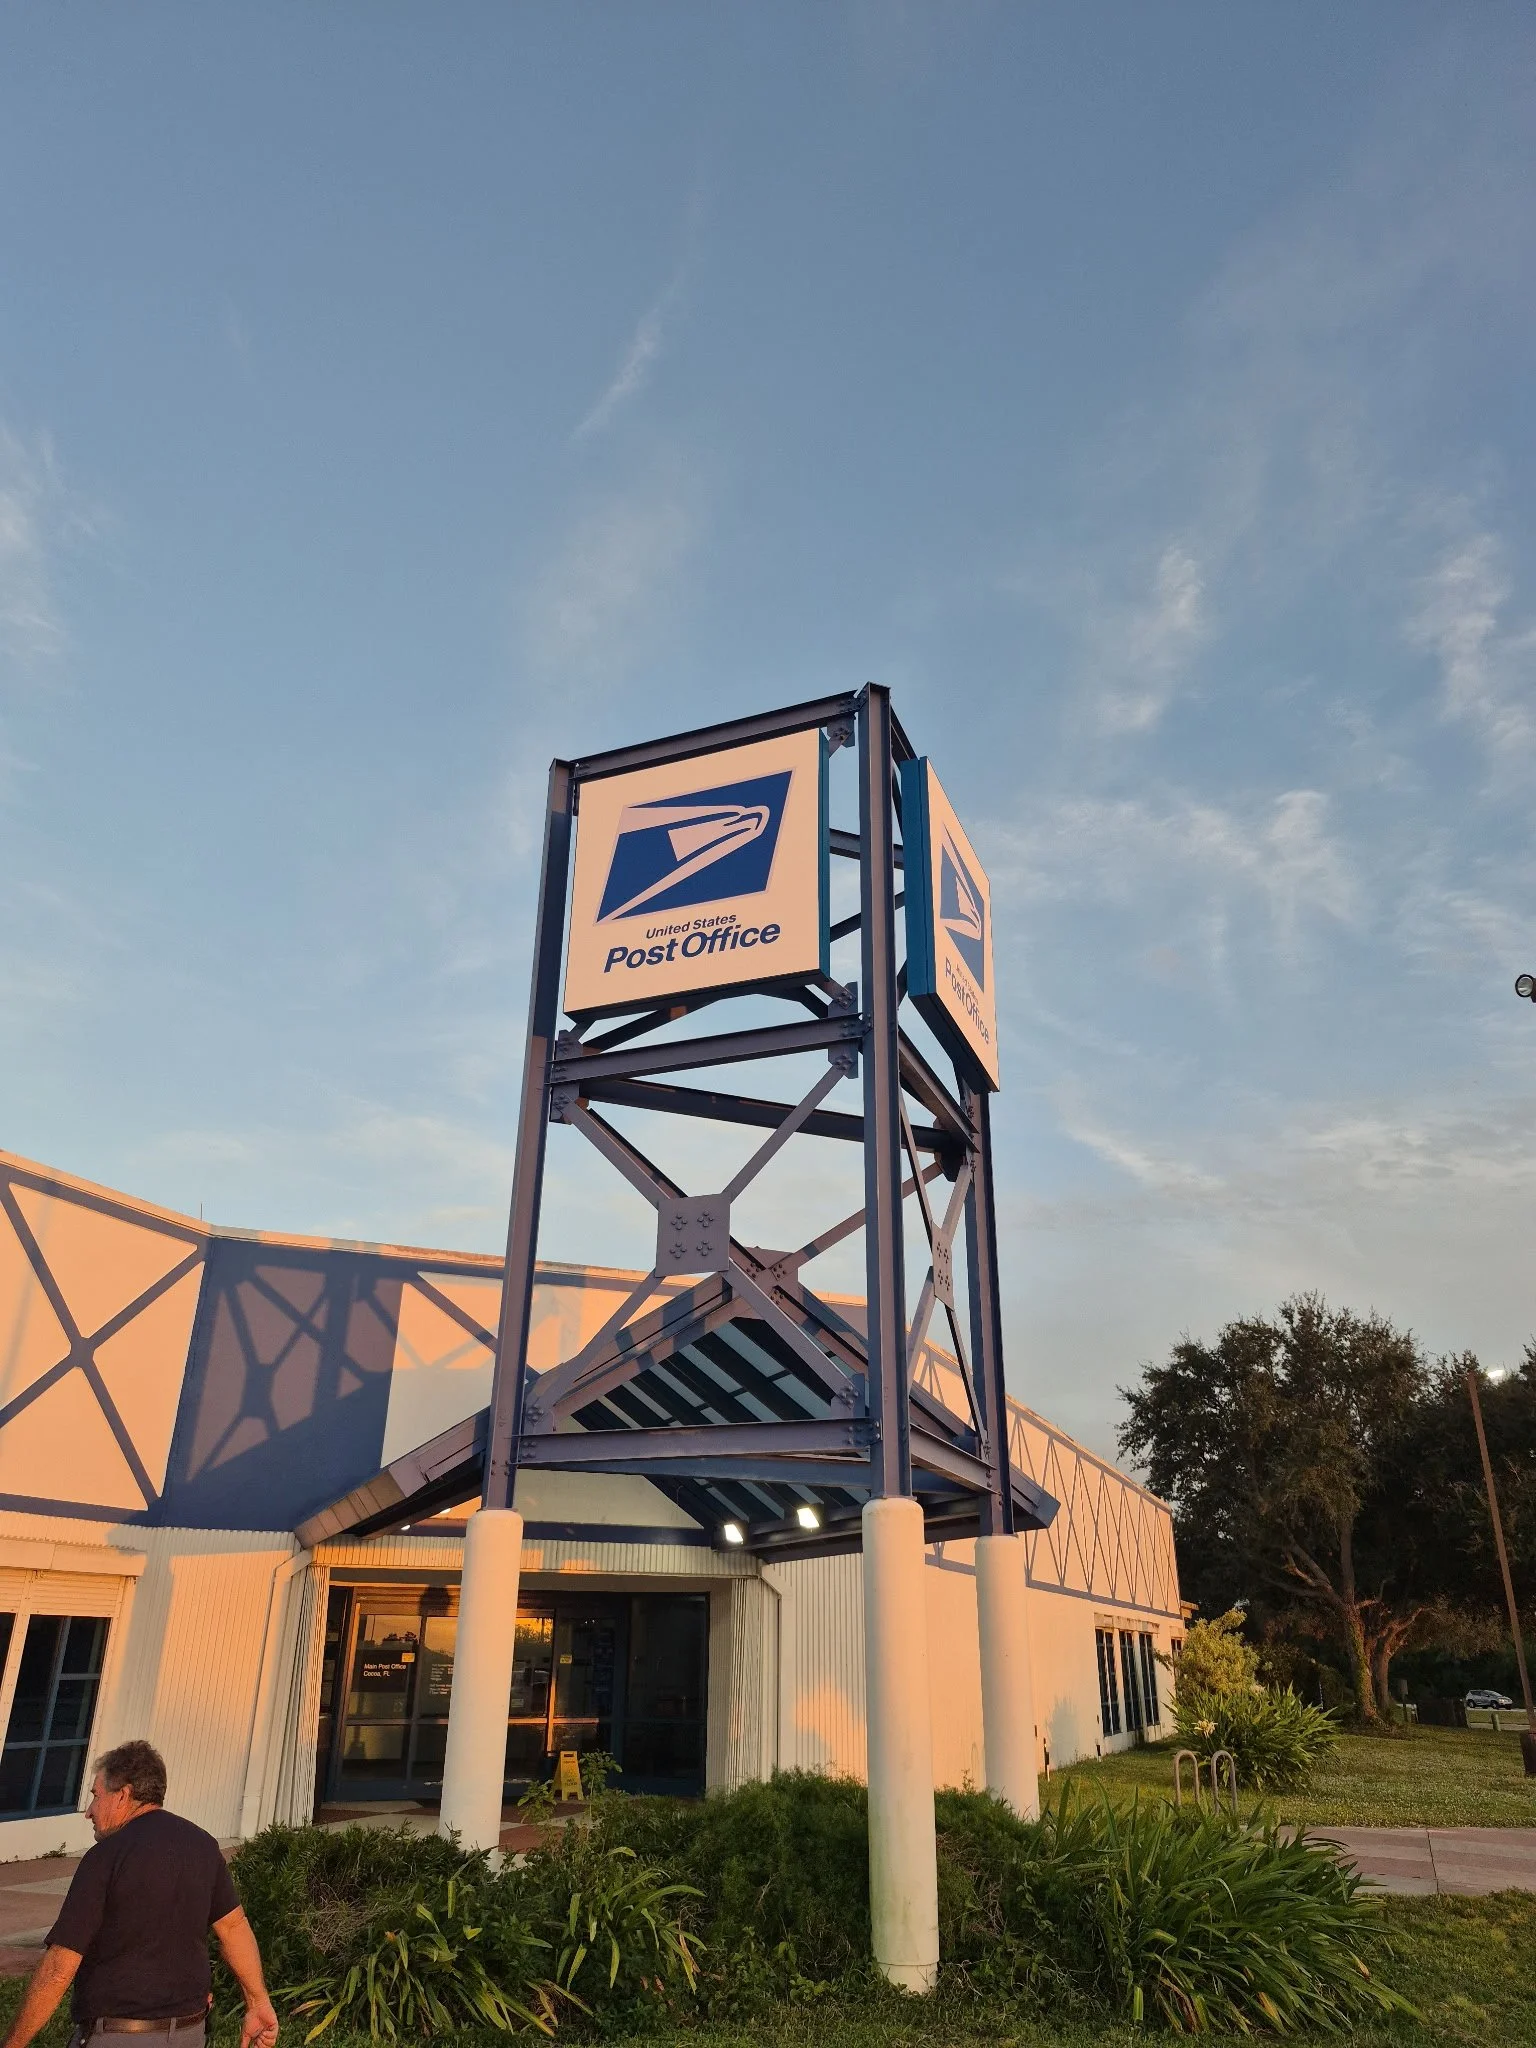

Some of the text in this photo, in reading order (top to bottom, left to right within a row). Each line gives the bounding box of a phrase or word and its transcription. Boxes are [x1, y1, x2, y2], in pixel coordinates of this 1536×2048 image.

[604, 923, 781, 973] Post Office
[646, 914, 737, 939] United States
[945, 956, 965, 1006] Post
